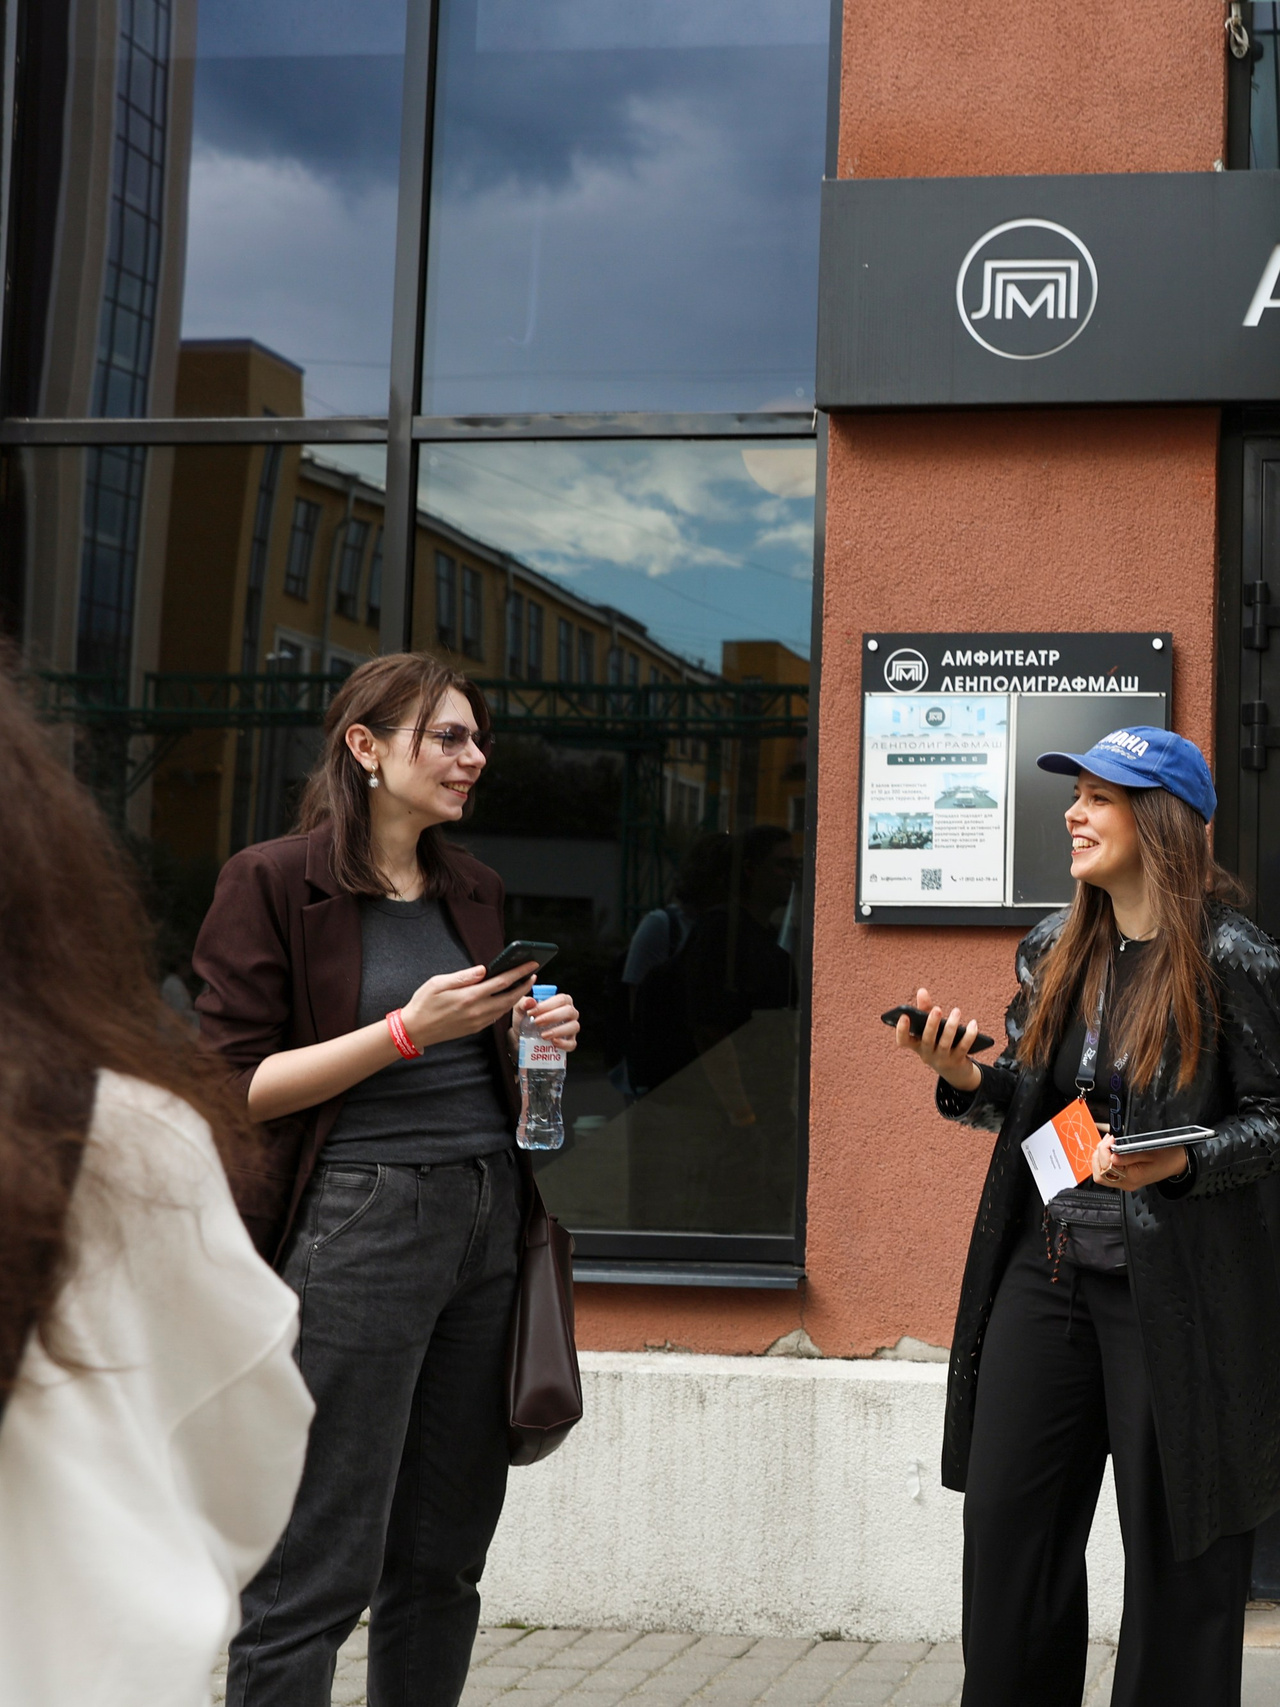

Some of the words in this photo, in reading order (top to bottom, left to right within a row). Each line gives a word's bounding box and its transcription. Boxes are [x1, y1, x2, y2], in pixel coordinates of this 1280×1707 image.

[941, 649, 1060, 667] АМФИТЕАТР
[940, 675, 1140, 693] ЛЕНПОЛИГРАФМАШ
[871, 740, 1003, 750] ЛЕНПОЛИГРАФМАШ
